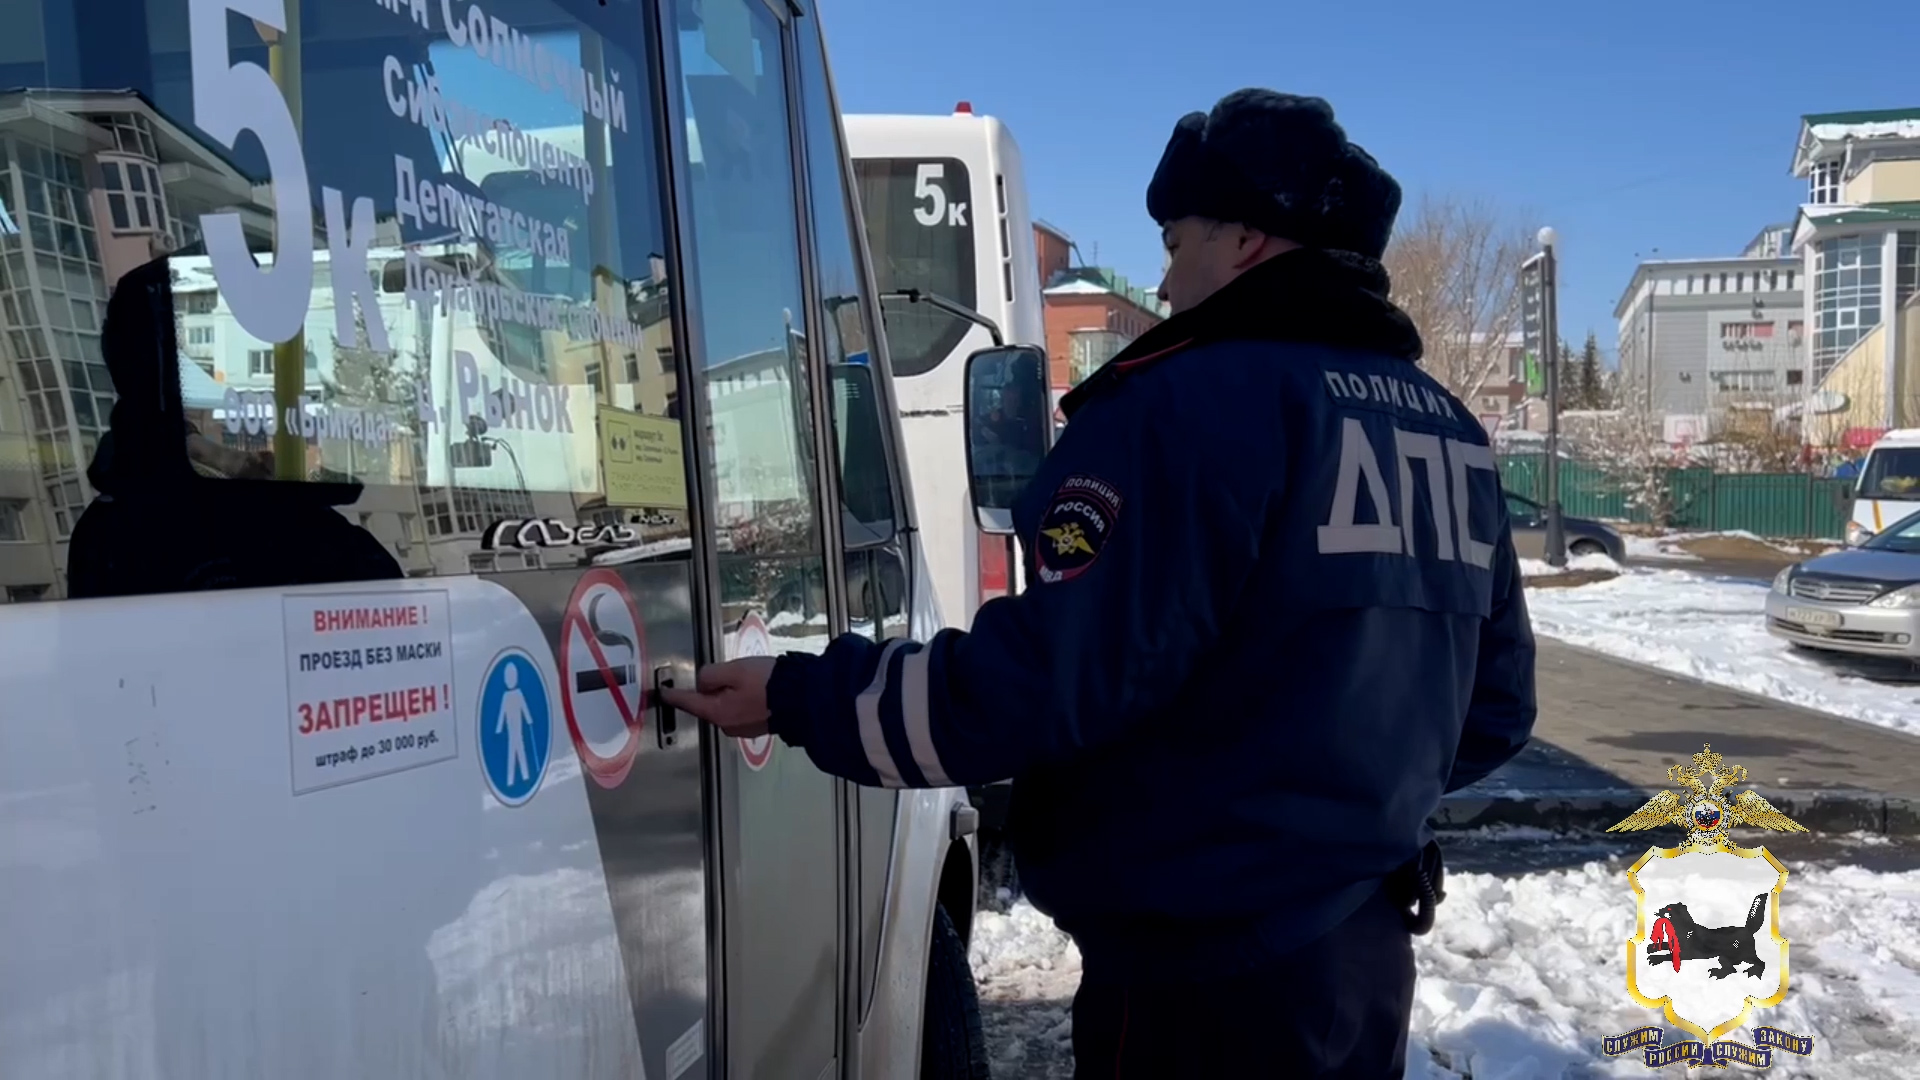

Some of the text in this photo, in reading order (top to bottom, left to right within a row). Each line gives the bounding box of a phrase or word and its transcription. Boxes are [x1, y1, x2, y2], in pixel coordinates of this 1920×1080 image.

[395, 154, 570, 262] Депутатская
[913, 163, 967, 226] 5к
[224, 388, 278, 435] ООО
[454, 350, 574, 434] Рынок
[1065, 478, 1120, 507] ПОЛИЦИЯ
[1317, 417, 1495, 570] ДПС
[1054, 502, 1105, 533] РОССИЯ
[313, 606, 418, 632] ВНИМАНИЕ
[300, 642, 442, 672] ПРОЕЗД БЕЗ МАСКИ
[298, 685, 437, 735] ЗАПРЕЩЕН
[315, 730, 439, 767] штраф до 30 000 руб.
